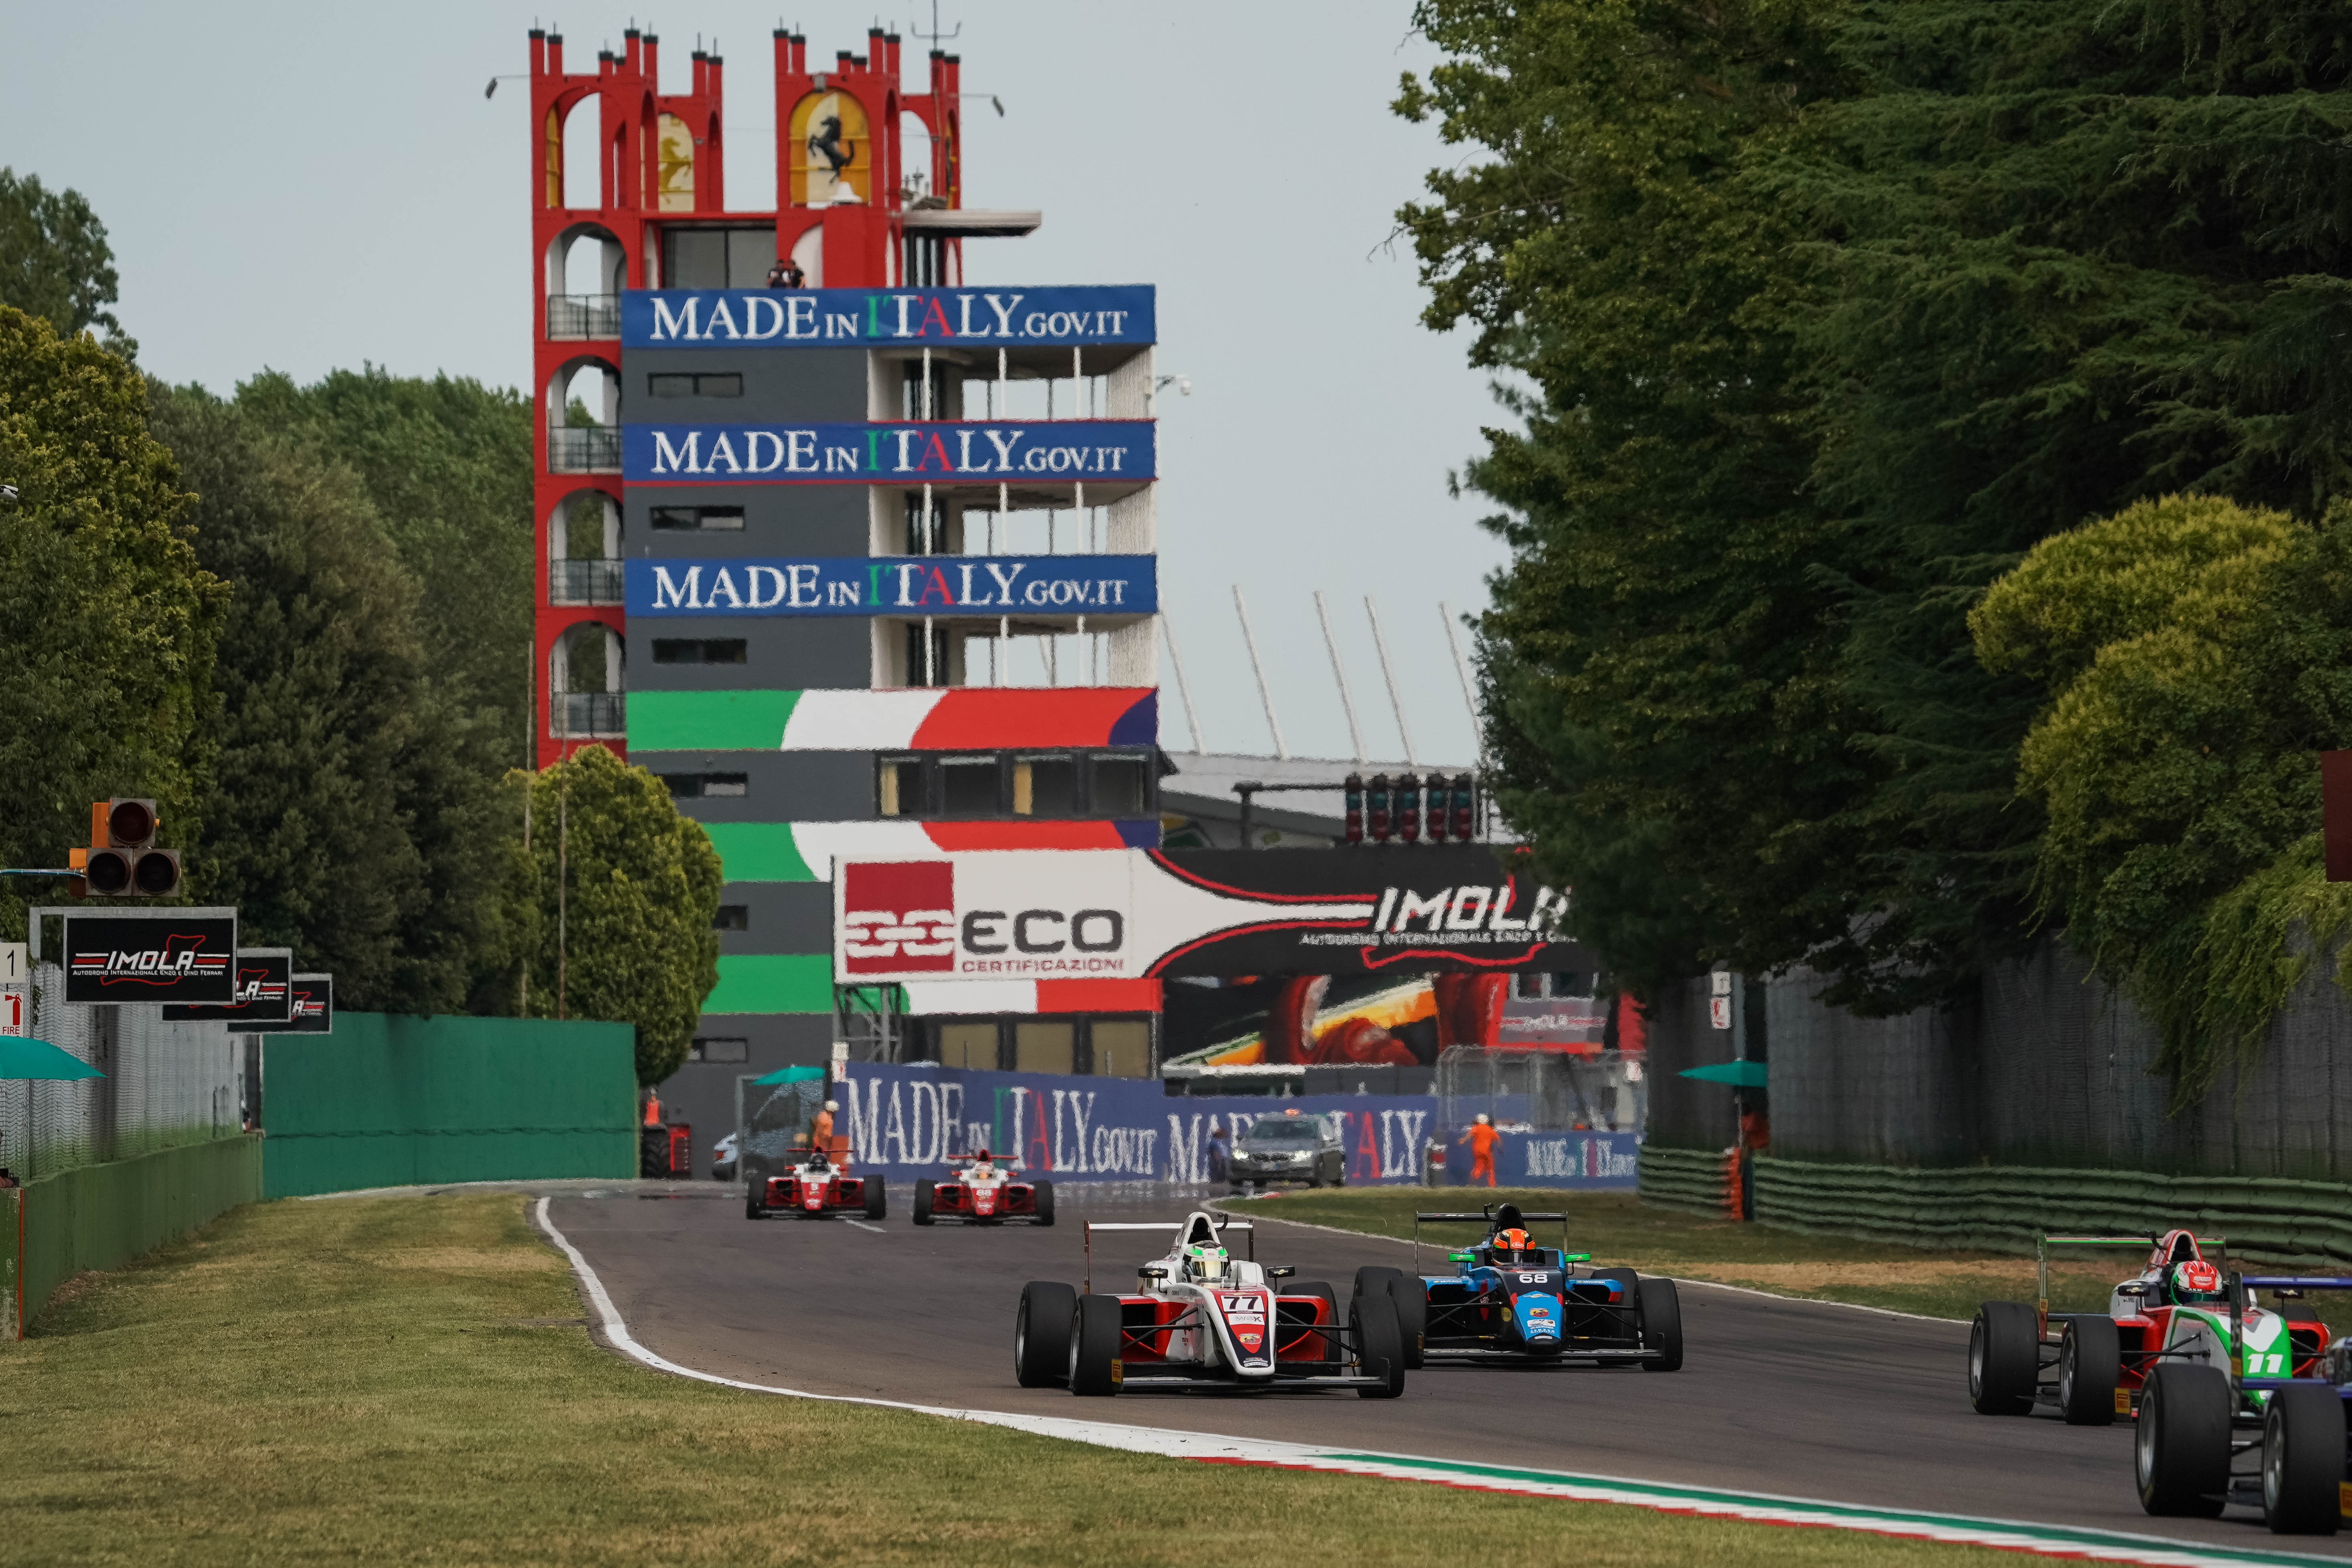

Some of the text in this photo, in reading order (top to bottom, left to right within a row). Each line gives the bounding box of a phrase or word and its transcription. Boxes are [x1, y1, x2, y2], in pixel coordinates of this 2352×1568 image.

[650, 297, 818, 340] MADE
[825, 313, 858, 338] IN
[651, 430, 819, 473] MADE
[825, 447, 858, 473] IN
[652, 565, 821, 608] MADE
[827, 581, 860, 606] IN
[962, 909, 1124, 955] ECO
[7, 950, 14, 976] 1
[106, 951, 195, 970] IMOLA
[962, 958, 1124, 973] CERTIFICAZIONI
[2, 1026, 20, 1035] FIRE
[845, 1078, 964, 1165] MADE
[1519, 1274, 1548, 1283] 68
[1223, 1297, 1259, 1310] 77
[2247, 1353, 2283, 1374] 11
